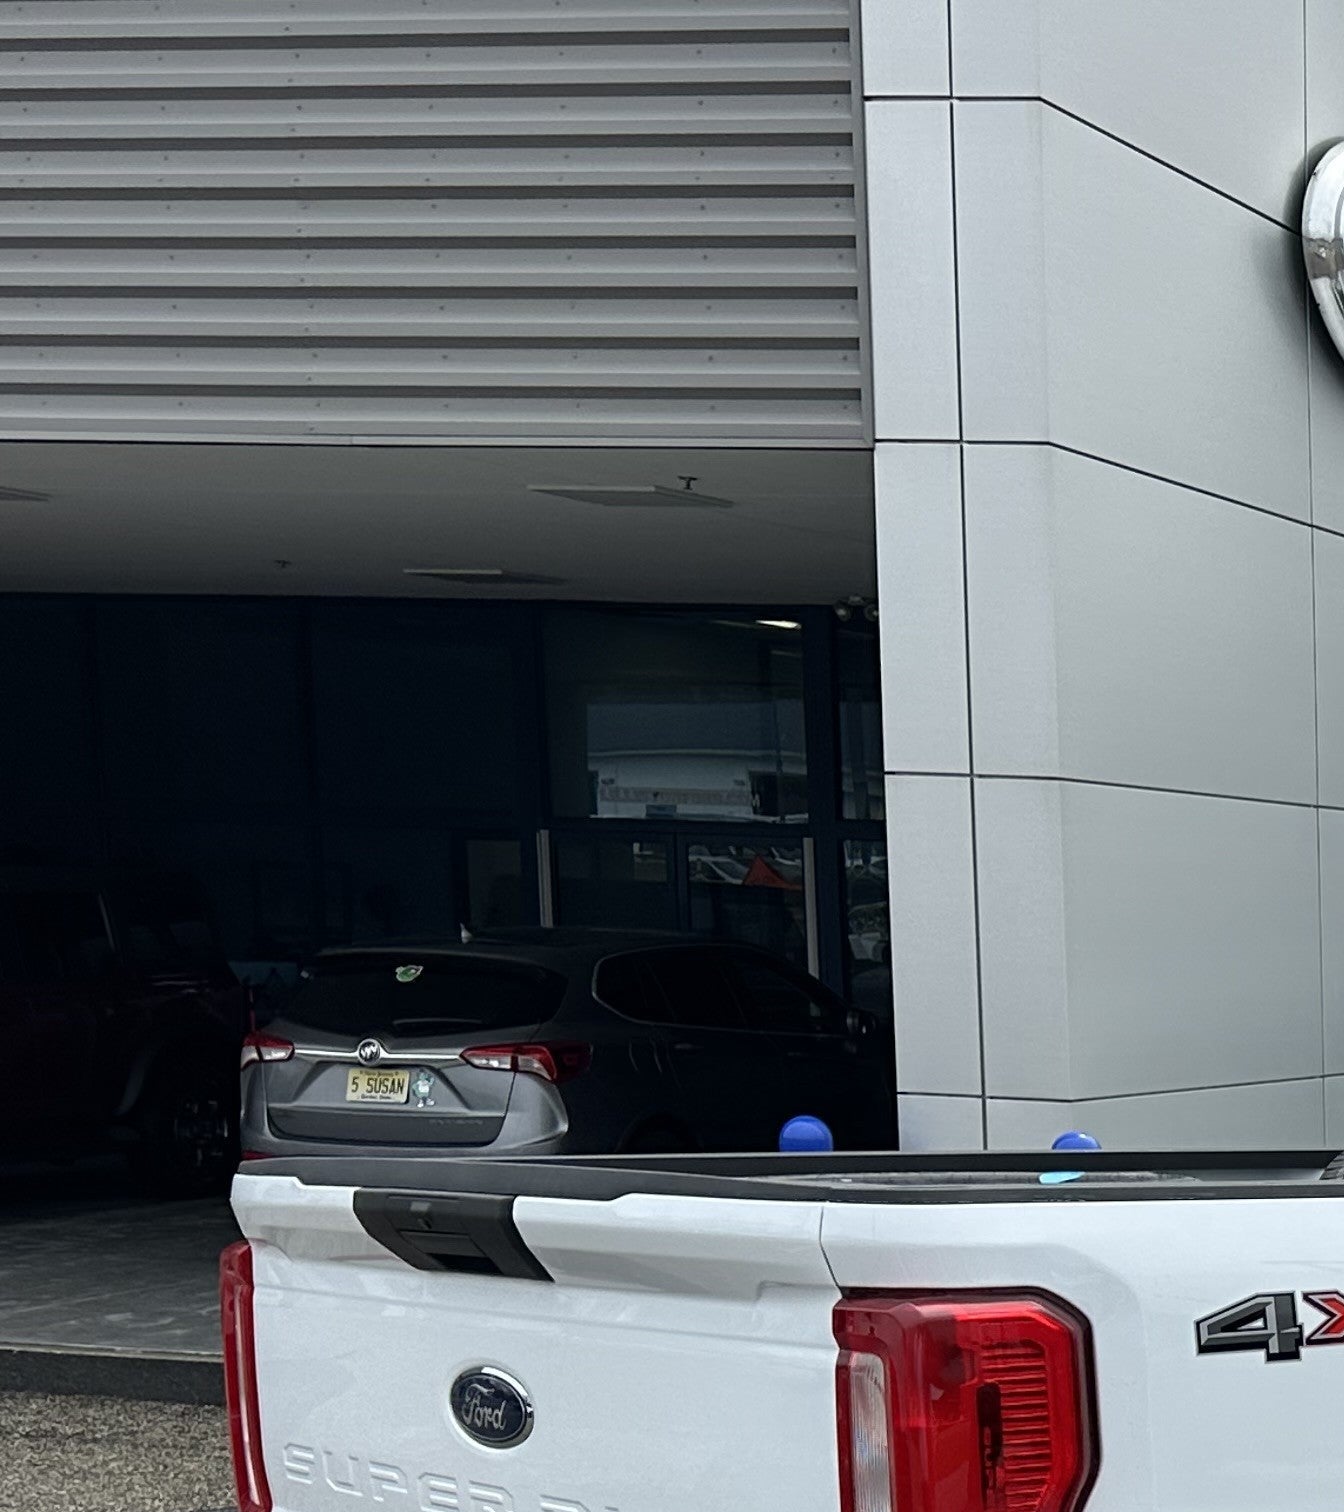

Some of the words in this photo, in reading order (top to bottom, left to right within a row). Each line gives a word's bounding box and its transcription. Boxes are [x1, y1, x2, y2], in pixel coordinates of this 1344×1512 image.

[351, 1076, 360, 1093] 5
[366, 1077, 405, 1094] SUSAN
[461, 1383, 508, 1431] Ford
